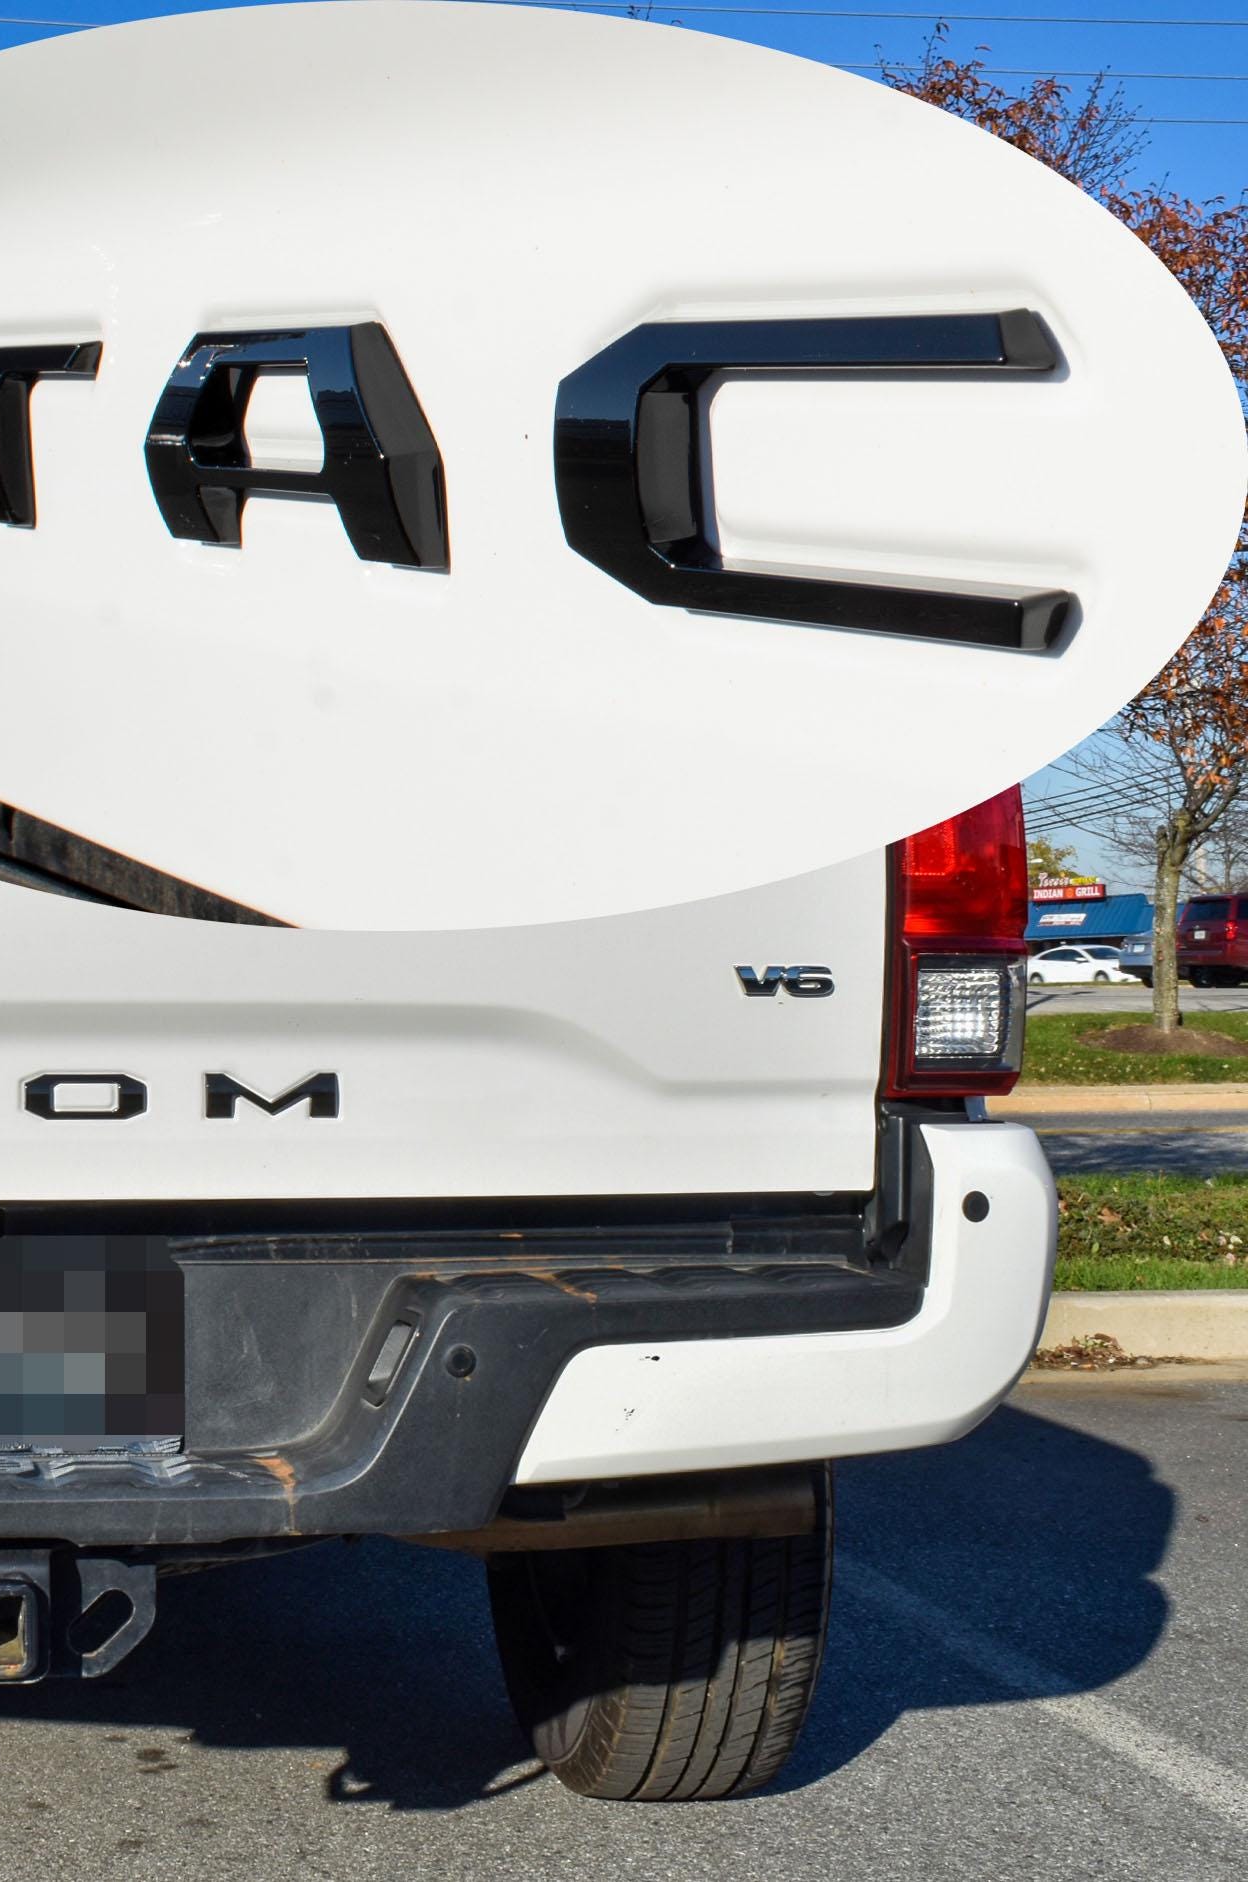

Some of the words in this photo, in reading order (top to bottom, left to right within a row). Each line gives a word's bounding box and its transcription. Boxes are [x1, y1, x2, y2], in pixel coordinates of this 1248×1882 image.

[1033, 888, 1064, 899] INDIAN
[1075, 886, 1101, 897] GRILL
[733, 965, 835, 998] V6
